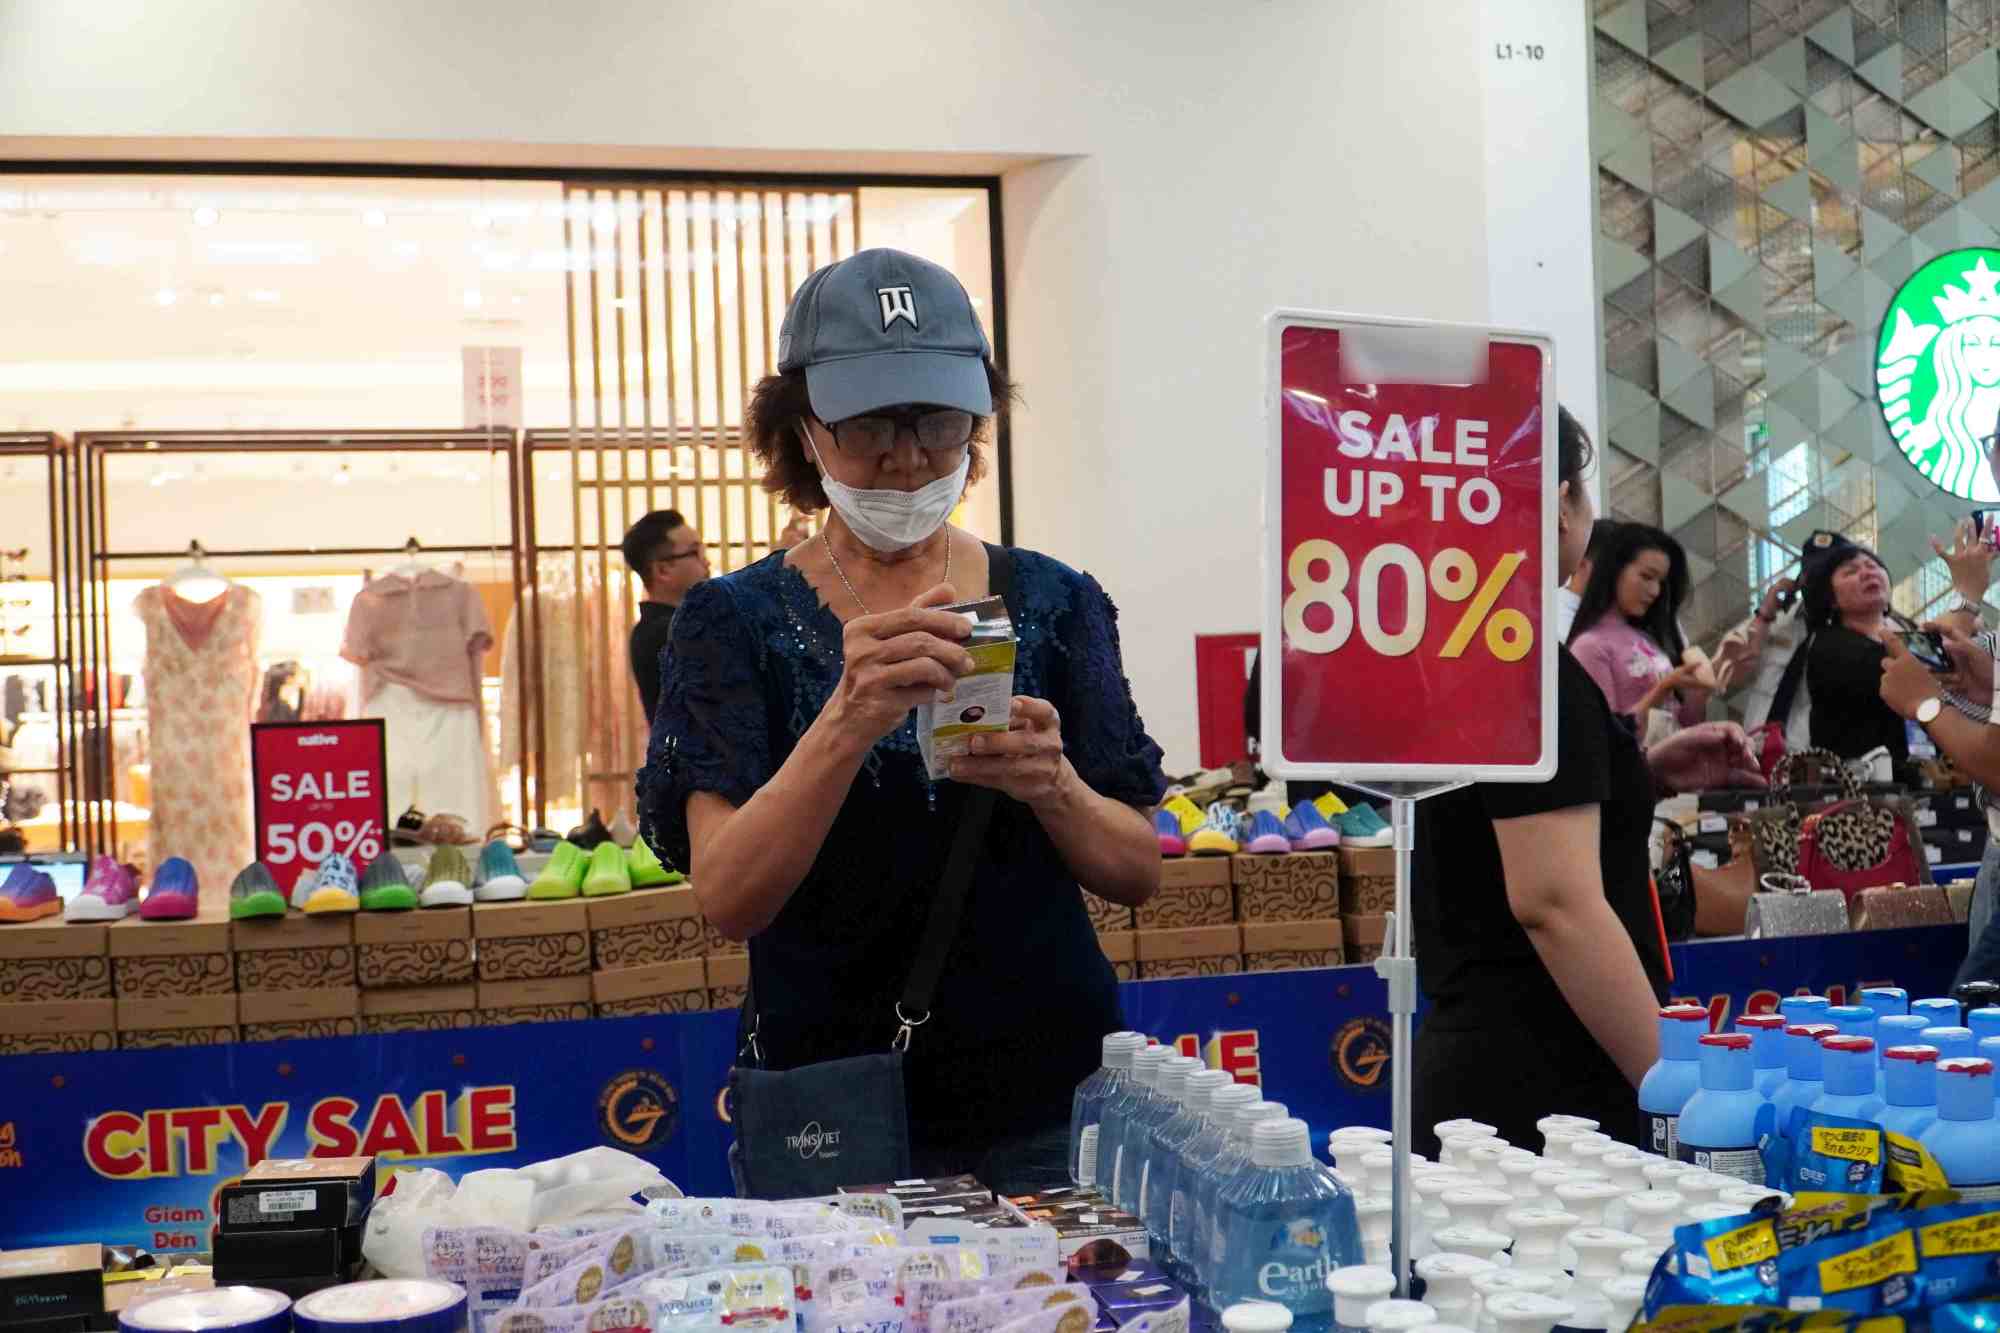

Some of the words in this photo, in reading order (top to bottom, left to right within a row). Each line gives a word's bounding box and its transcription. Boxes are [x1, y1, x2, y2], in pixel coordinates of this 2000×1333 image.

[1337, 410, 1489, 466] SALE
[1323, 467, 1404, 519] UP
[1420, 474, 1501, 525] TO
[1282, 538, 1535, 662] 80%
[297, 733, 339, 747] native
[270, 770, 371, 801] SALE
[266, 820, 380, 864] 50%
[84, 1102, 288, 1178] CITY
[307, 1086, 517, 1160] SALE
